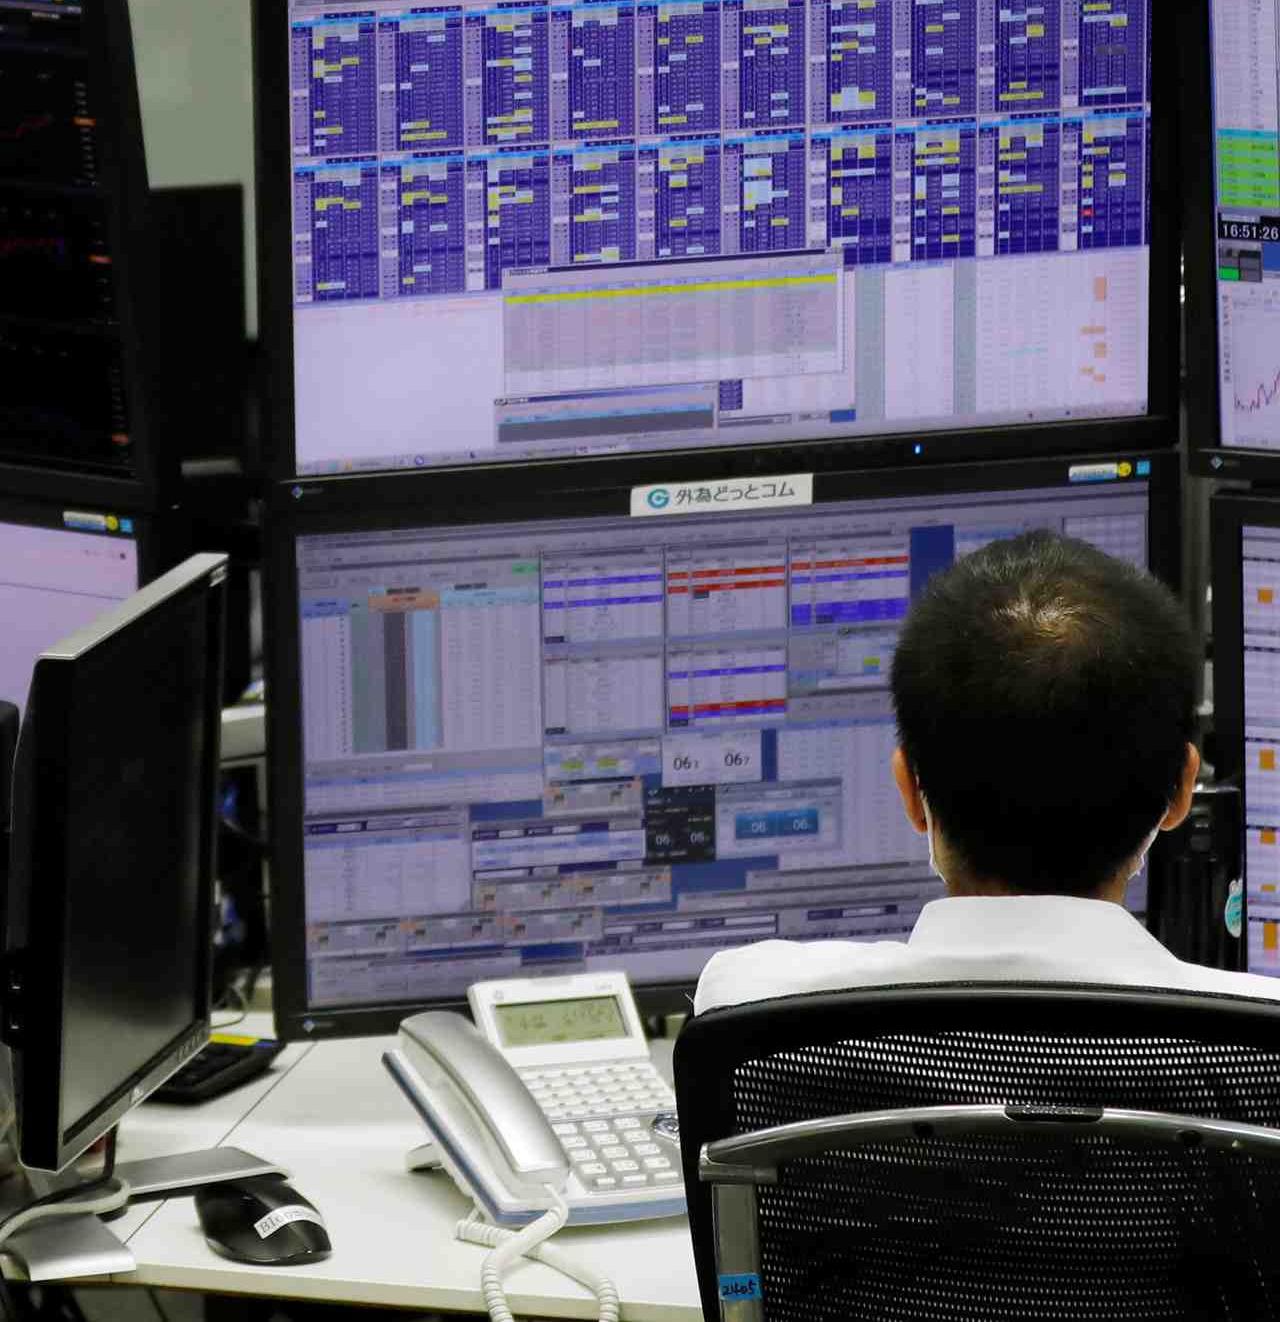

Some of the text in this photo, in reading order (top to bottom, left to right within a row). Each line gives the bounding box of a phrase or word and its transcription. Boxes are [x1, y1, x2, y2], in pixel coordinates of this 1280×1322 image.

[1221, 223, 1280, 241] 16:51:26
[674, 480, 796, 505] 外為どっとコム
